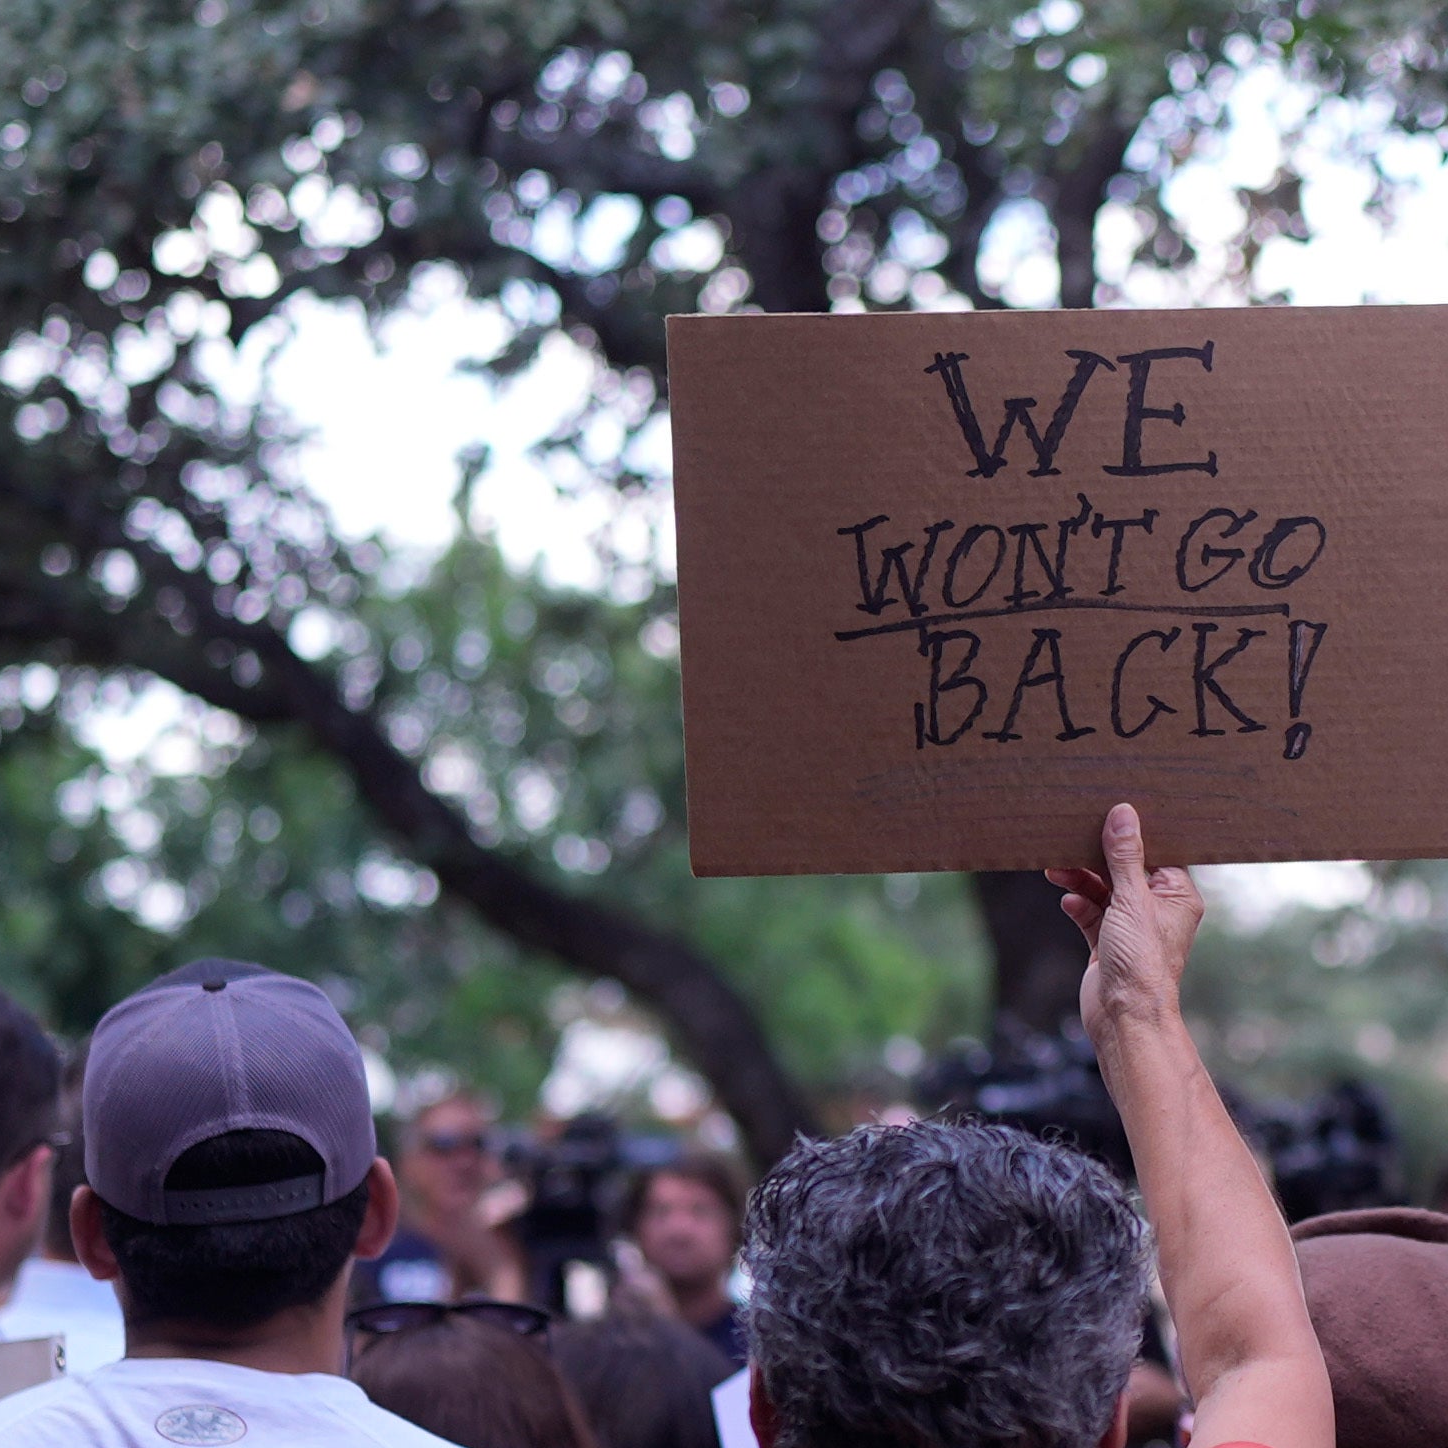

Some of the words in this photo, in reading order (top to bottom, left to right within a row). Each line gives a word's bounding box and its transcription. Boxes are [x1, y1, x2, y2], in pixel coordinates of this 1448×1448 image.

[924, 341, 1219, 478] WE
[837, 492, 1159, 615] WON'T
[1175, 508, 1327, 594] GO
[914, 619, 1329, 761] BACK!
